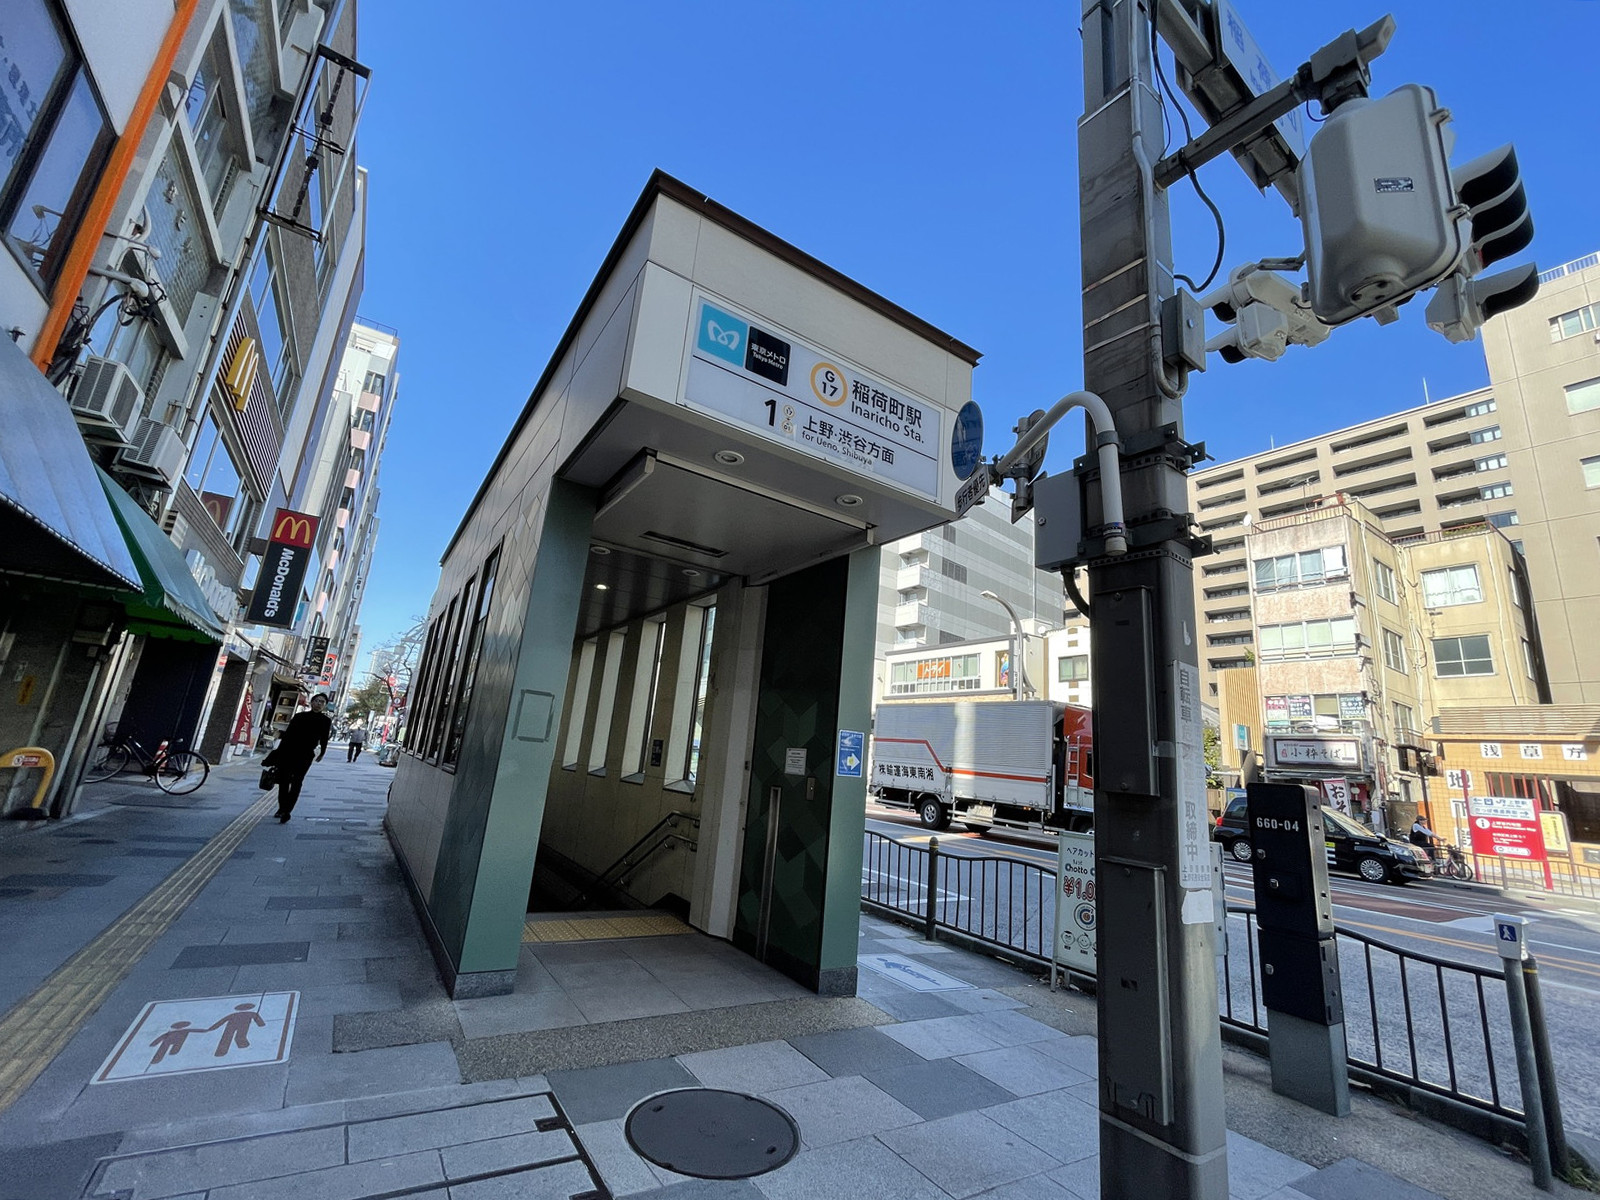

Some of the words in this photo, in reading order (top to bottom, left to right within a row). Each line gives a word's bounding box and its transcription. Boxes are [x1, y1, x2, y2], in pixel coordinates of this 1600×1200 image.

[751, 343, 786, 365] 東京メトロ
[752, 351, 767, 363] Tokyo
[768, 358, 783, 370] Metro
[825, 370, 835, 382] G
[822, 381, 838, 397] 17
[764, 399, 777, 427] 1
[852, 379, 922, 429] 稲荷町駅
[851, 401, 900, 432] Inaricho
[904, 425, 924, 444] Sta.
[802, 431, 814, 441] for
[816, 437, 840, 454] Ueno,
[841, 444, 873, 466] Shibuya
[264, 547, 295, 618] McDonald's
[1256, 817, 1299, 832] 660-04
[1066, 847, 1095, 858] ヘアカット
[1065, 863, 1088, 875] Chotto
